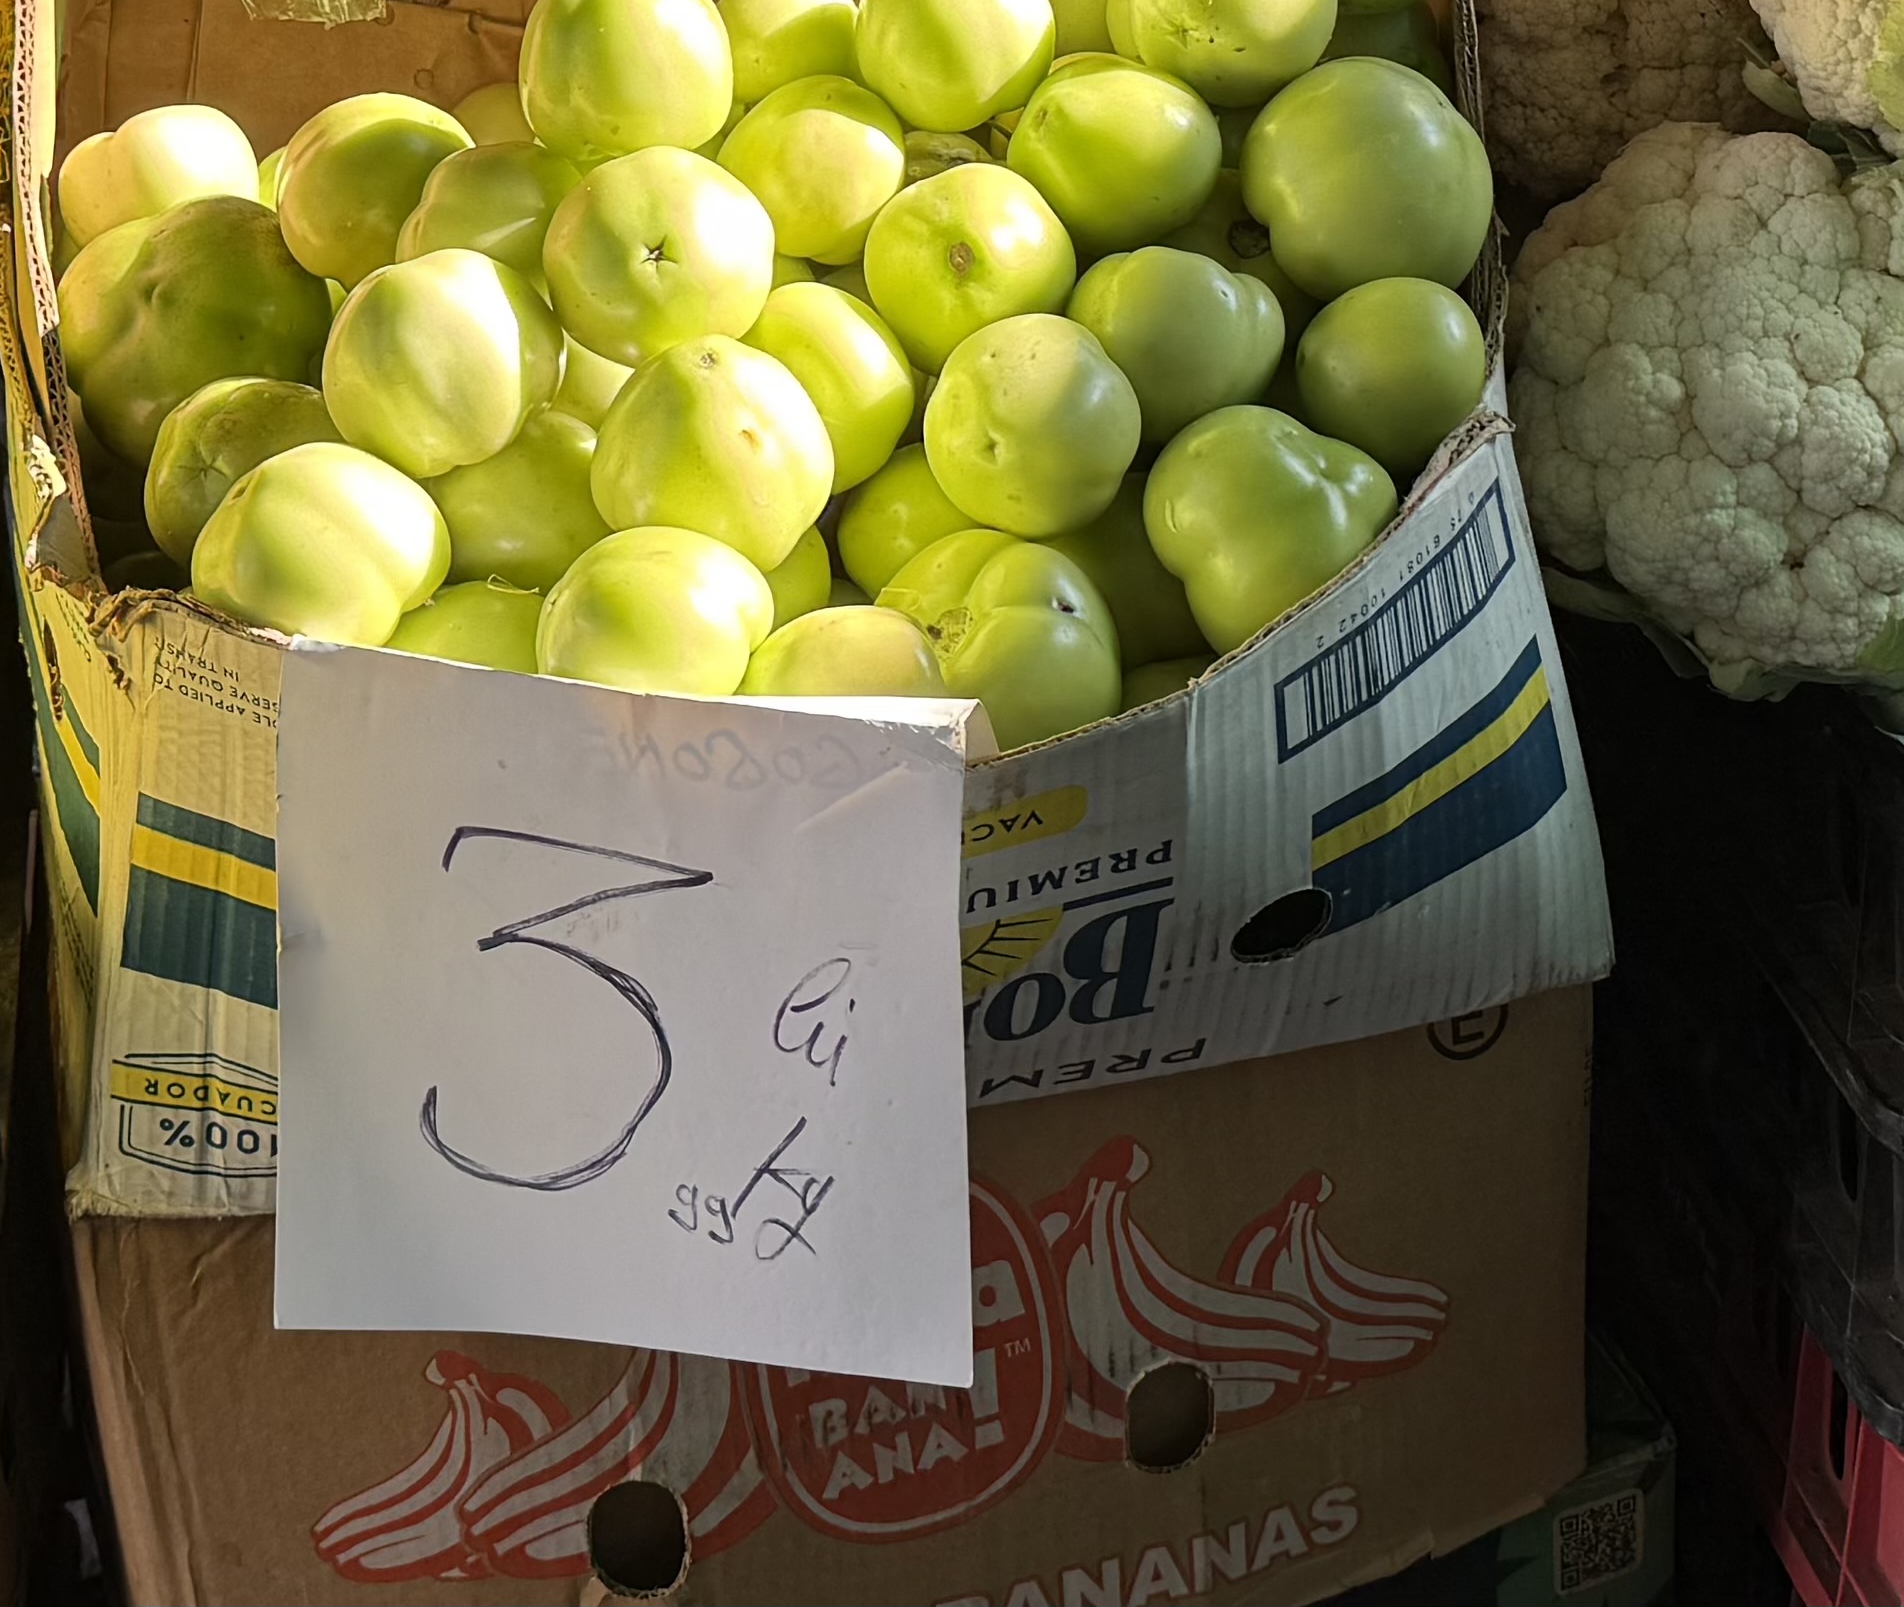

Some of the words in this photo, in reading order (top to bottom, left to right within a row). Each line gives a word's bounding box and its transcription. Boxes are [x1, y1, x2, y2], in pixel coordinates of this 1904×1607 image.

[152, 672, 173, 692] TO
[222, 666, 240, 683] IN
[178, 683, 246, 716] APPLIED
[229, 684, 279, 713] SERVE
[962, 809, 1043, 844] VAC
[965, 839, 1174, 914] PREMIU
[962, 897, 1175, 1042] BO
[418, 825, 714, 1192] 3
[772, 957, 858, 1086] lei
[978, 1038, 1207, 1099] PREM
[142, 1077, 278, 1116] CUADOR
[158, 1117, 278, 1156] 100%
[934, 1483, 1361, 1607] ANANAS
